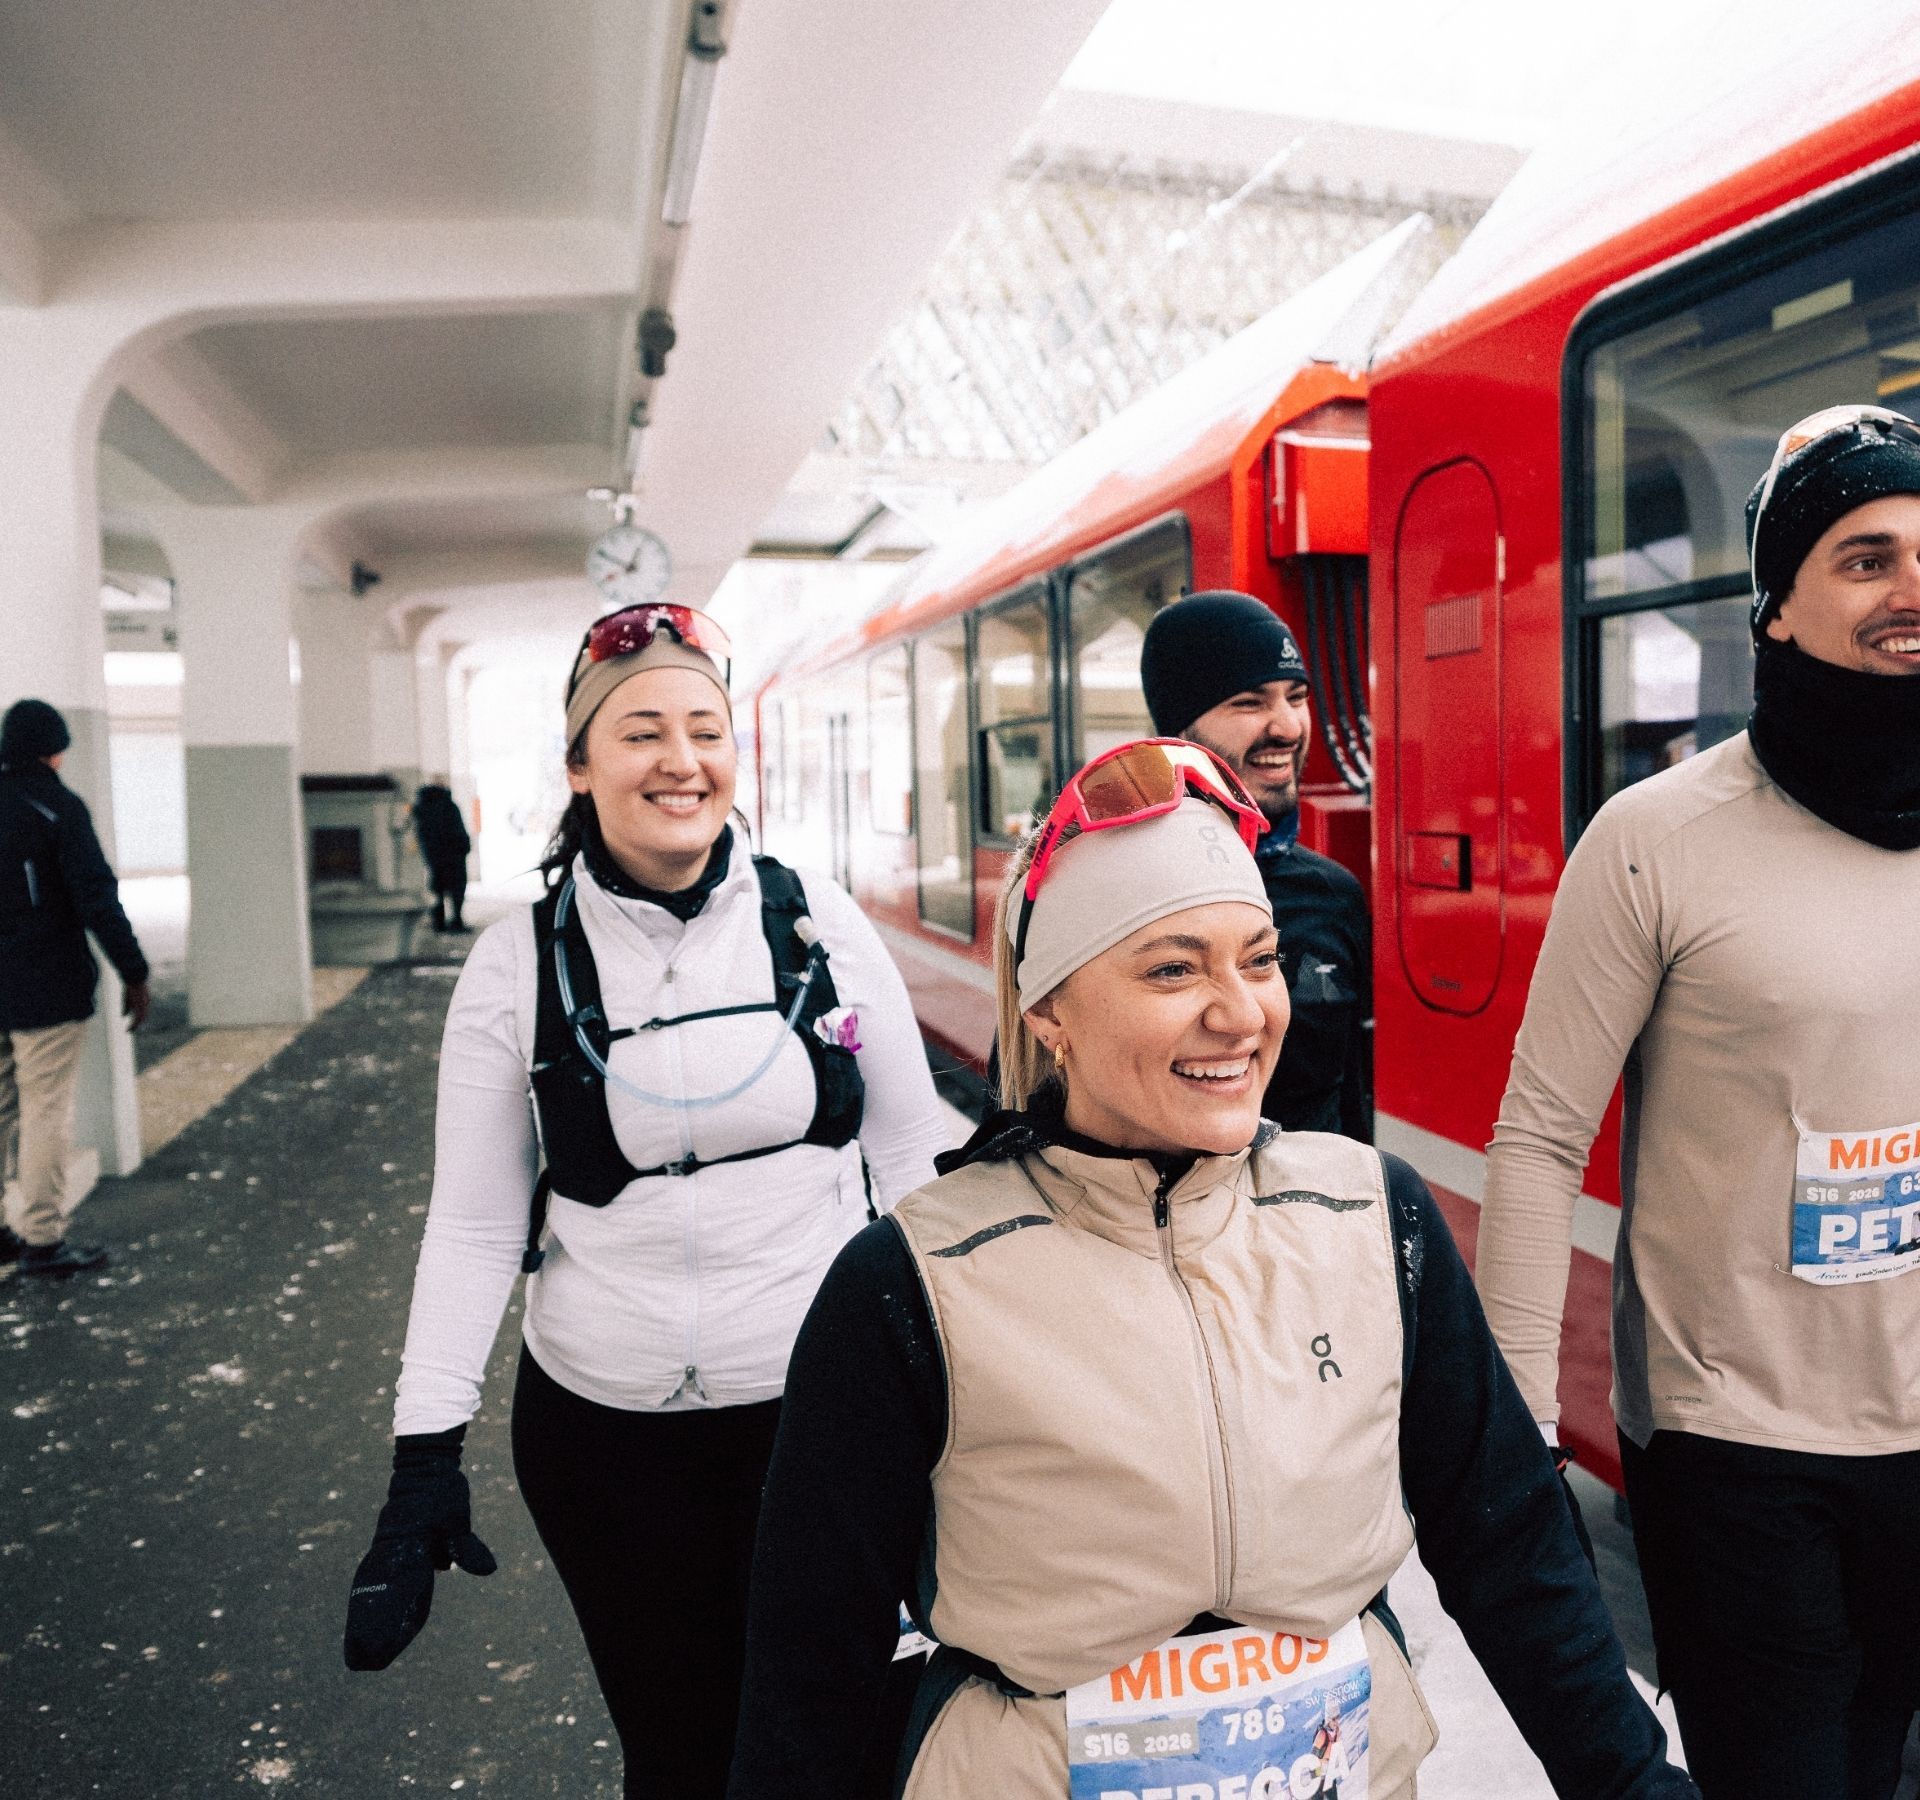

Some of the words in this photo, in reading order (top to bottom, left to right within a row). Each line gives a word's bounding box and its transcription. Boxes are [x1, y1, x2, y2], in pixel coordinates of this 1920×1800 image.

[1806, 1186, 1839, 1202] S16
[1848, 1187, 1880, 1201] 2026
[1084, 1732, 1130, 1757] S16
[1143, 1732, 1193, 1754] 2026
[1222, 1703, 1285, 1746] 786
